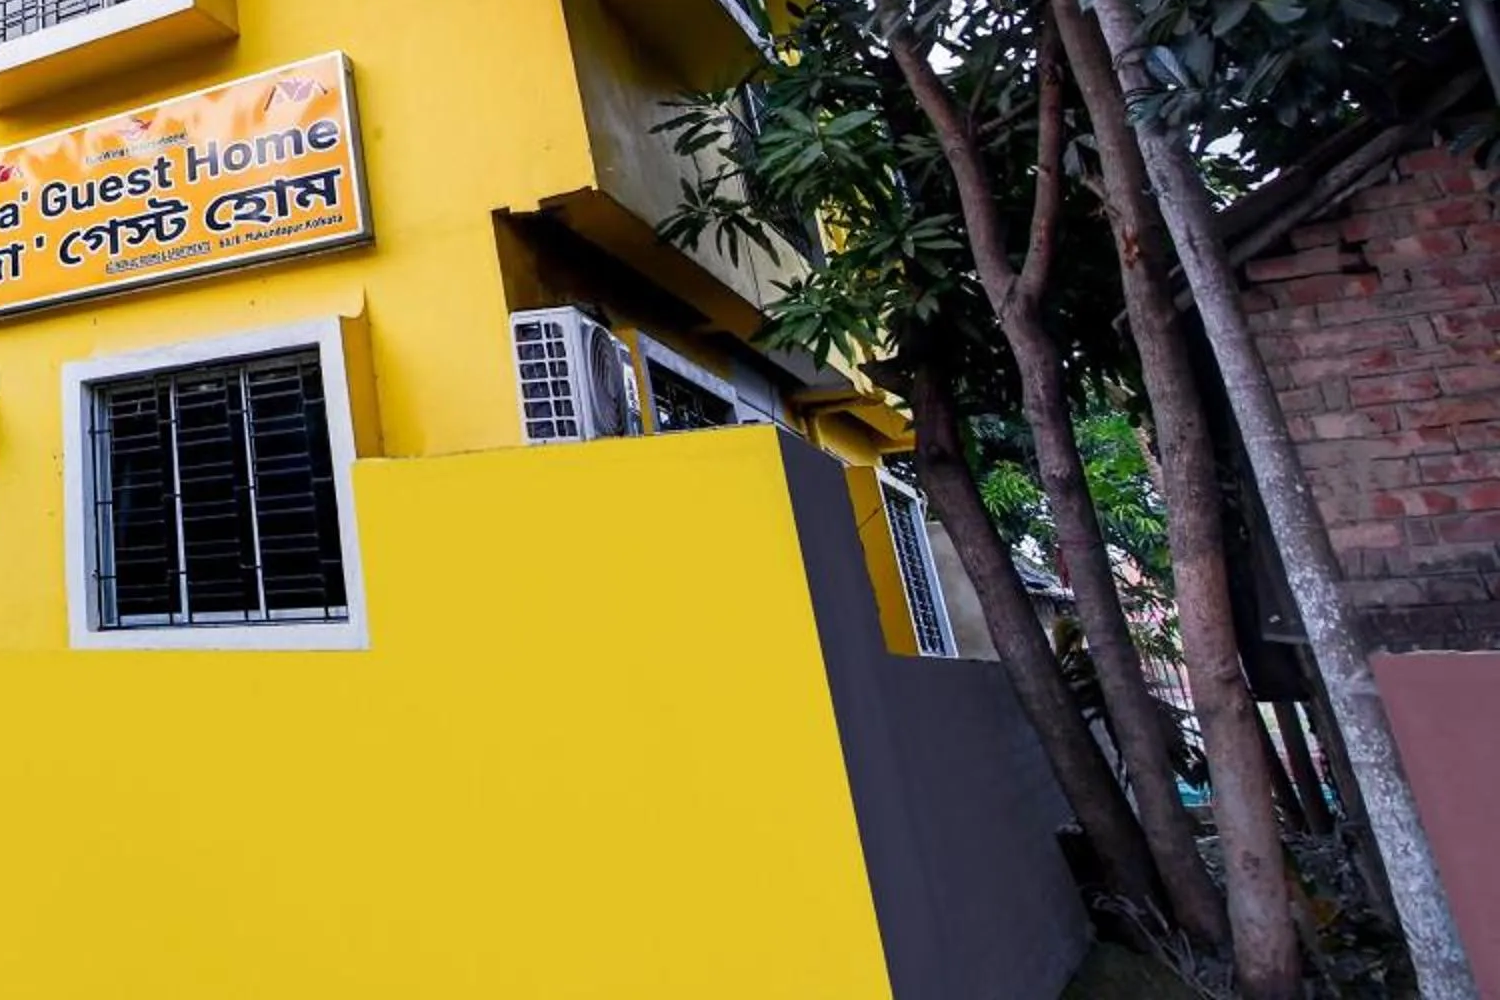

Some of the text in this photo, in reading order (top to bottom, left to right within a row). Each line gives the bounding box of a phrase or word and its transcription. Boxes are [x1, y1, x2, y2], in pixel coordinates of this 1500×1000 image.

[41, 156, 172, 217] Guest
[187, 120, 339, 182] Home
[59, 197, 189, 264] গেস্ট
[205, 168, 341, 231] হোম
